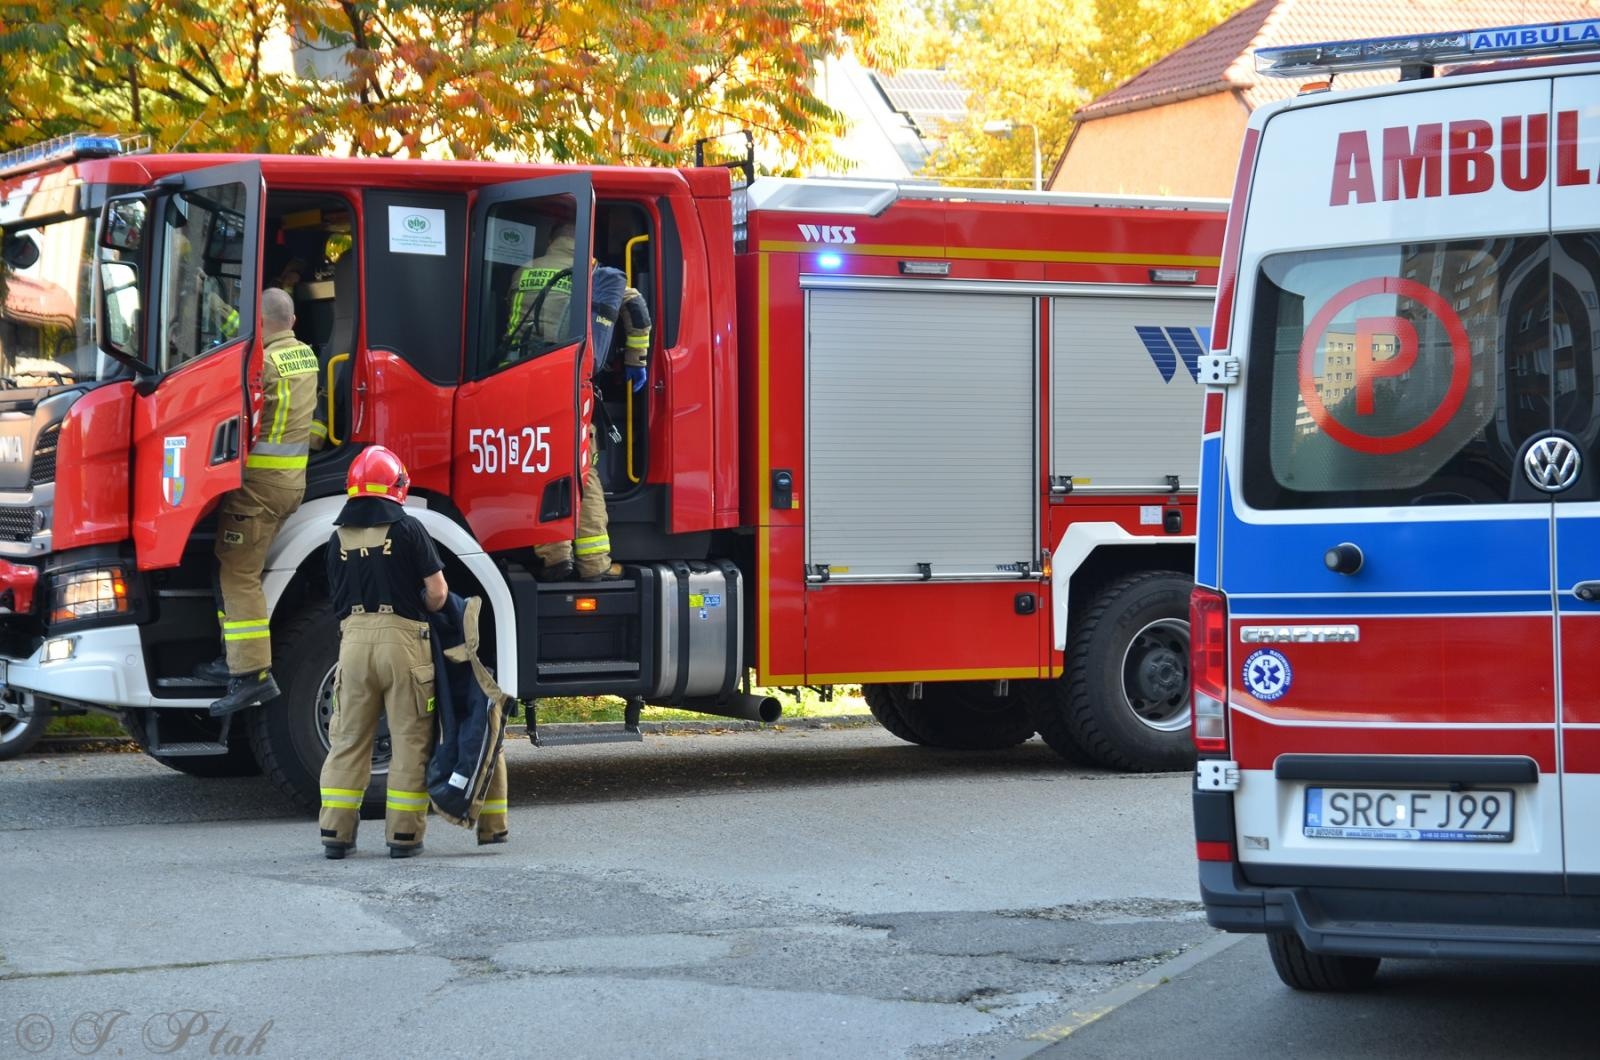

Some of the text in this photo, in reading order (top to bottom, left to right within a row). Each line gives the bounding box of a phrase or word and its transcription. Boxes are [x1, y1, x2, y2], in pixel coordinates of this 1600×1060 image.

[1329, 109, 1600, 207] AMBUL
[797, 223, 856, 244] WISS
[469, 427, 507, 474] 561
[521, 426, 551, 474] 25
[1241, 626, 1357, 642] CRAFTER
[1329, 792, 1396, 827] SRC
[1410, 793, 1501, 829] FJ99
